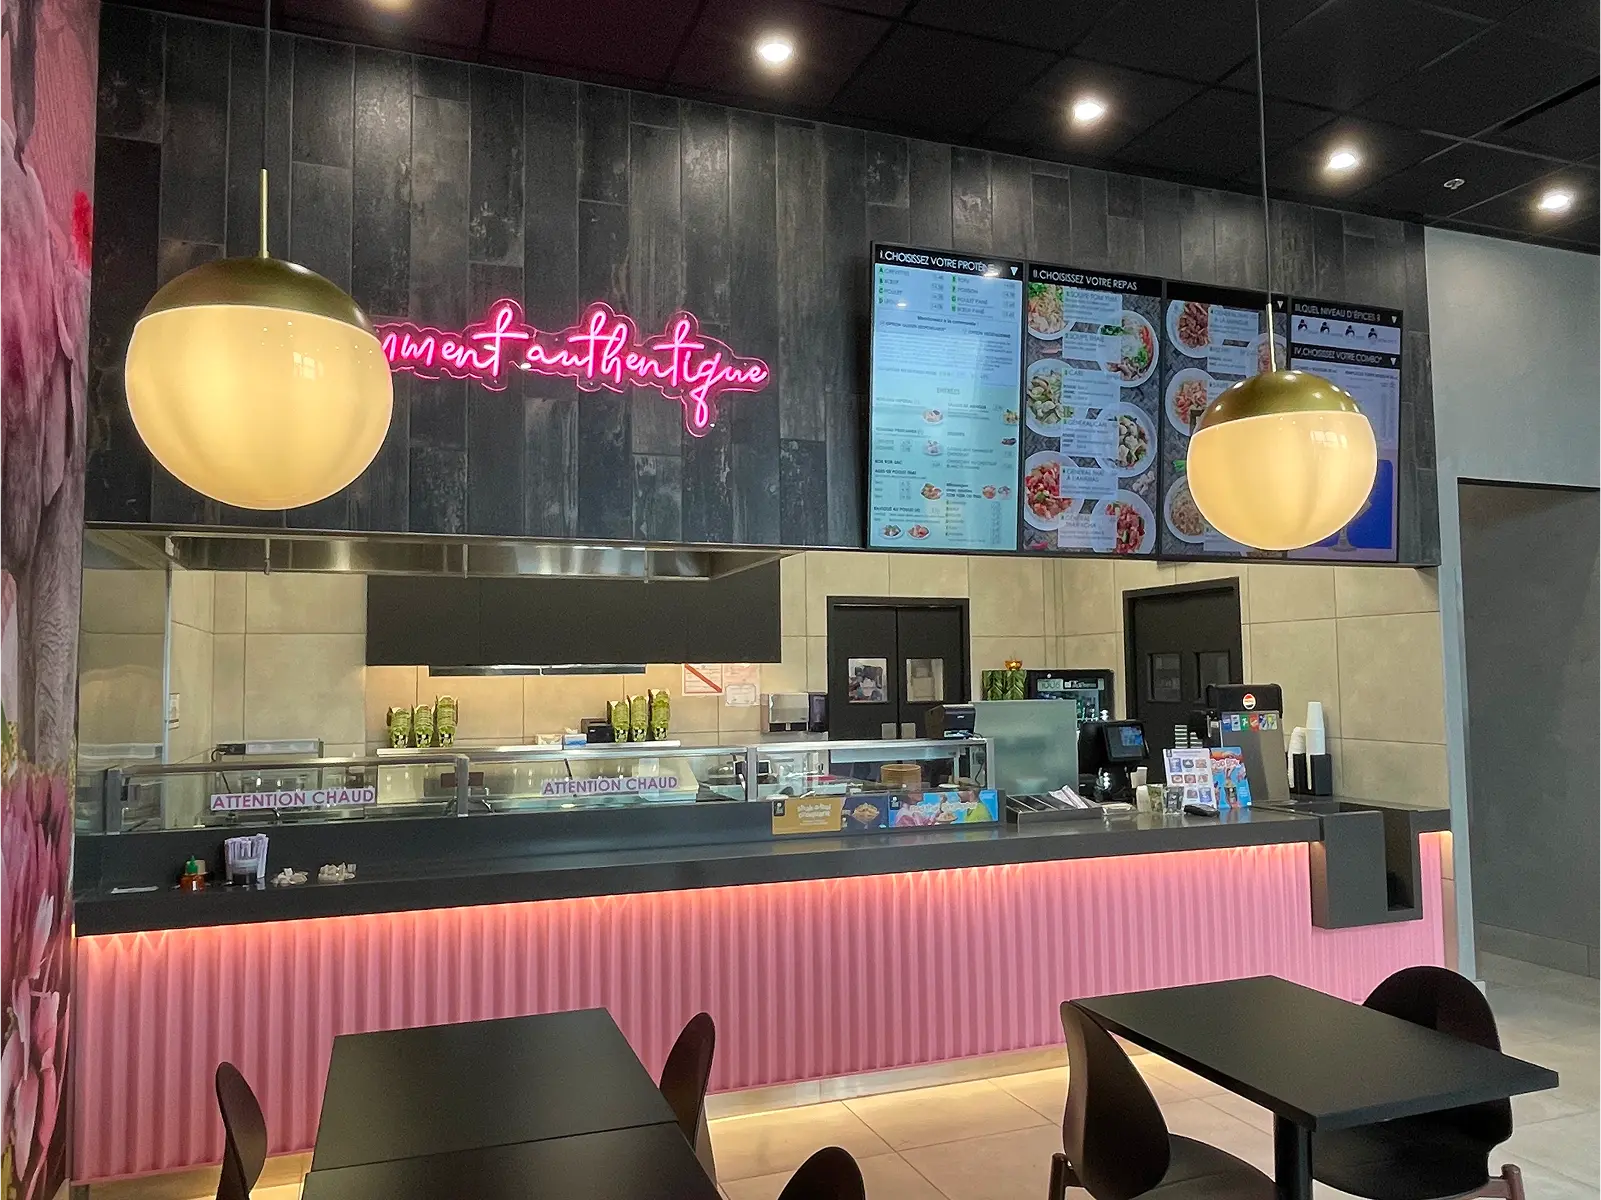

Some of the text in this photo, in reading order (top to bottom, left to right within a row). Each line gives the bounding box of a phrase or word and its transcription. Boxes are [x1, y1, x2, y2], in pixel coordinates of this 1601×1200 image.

[930, 256, 957, 268] VOTRE
[1086, 275, 1111, 288] VOTRE
[1113, 279, 1138, 291] REPAS
[1320, 306, 1346, 317] NIVEAU
[1336, 351, 1355, 362] VOTRE
[527, 310, 767, 427] authentique
[543, 775, 678, 796] ATTENTION CHAUD
[212, 787, 375, 810] ATTENTION CHAUD
